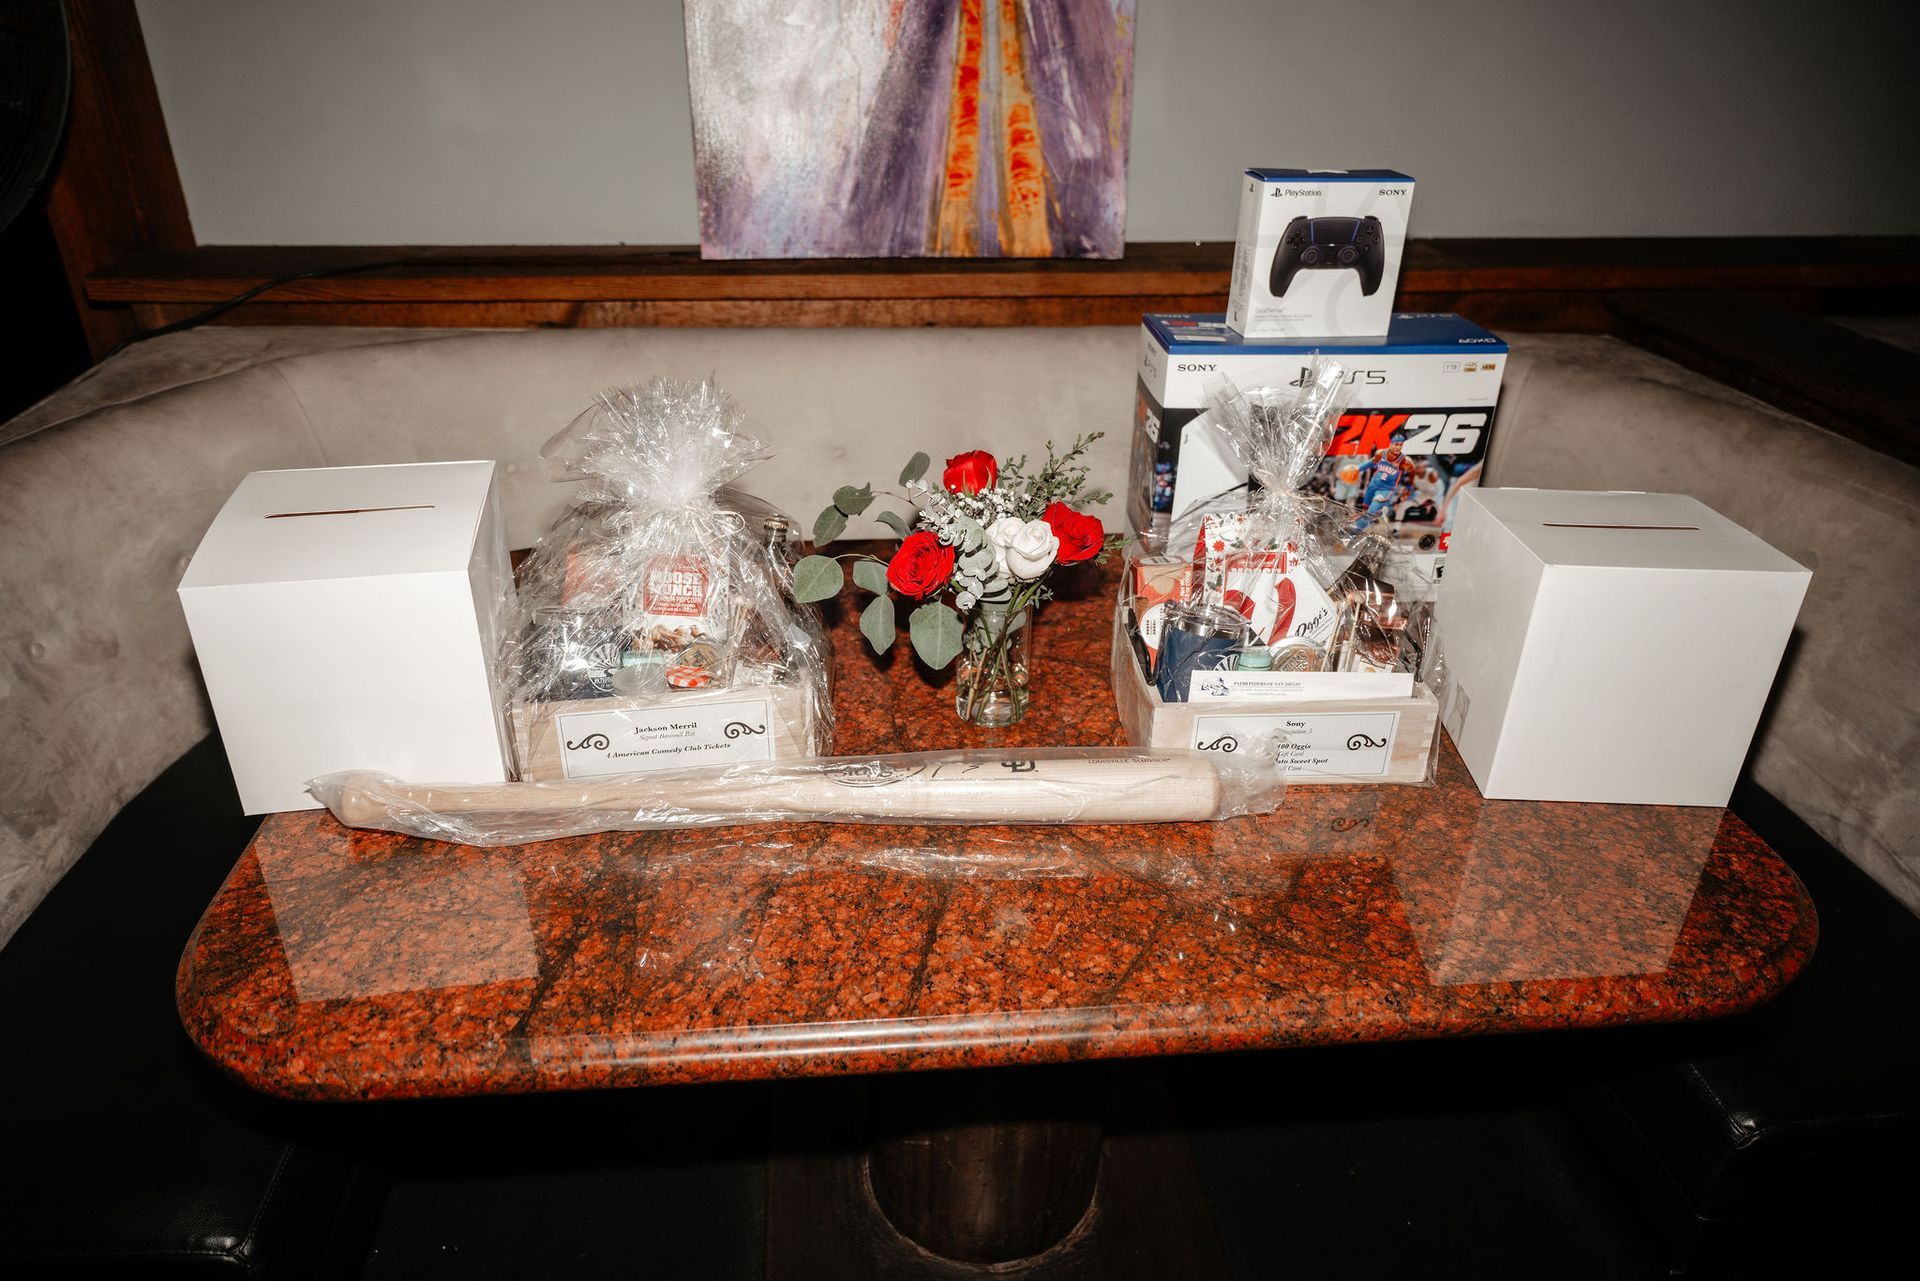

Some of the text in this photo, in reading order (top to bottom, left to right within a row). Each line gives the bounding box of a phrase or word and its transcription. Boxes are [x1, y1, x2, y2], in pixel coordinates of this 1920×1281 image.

[1285, 189, 1322, 197] PlayStation
[1177, 364, 1217, 372] SONY
[1295, 608, 1328, 637] Oggi's
[634, 722, 697, 735] Jackson Merril
[1286, 720, 1306, 728] Sony
[613, 750, 650, 759] American
[651, 746, 682, 755] Comedy
[684, 744, 702, 752] Club
